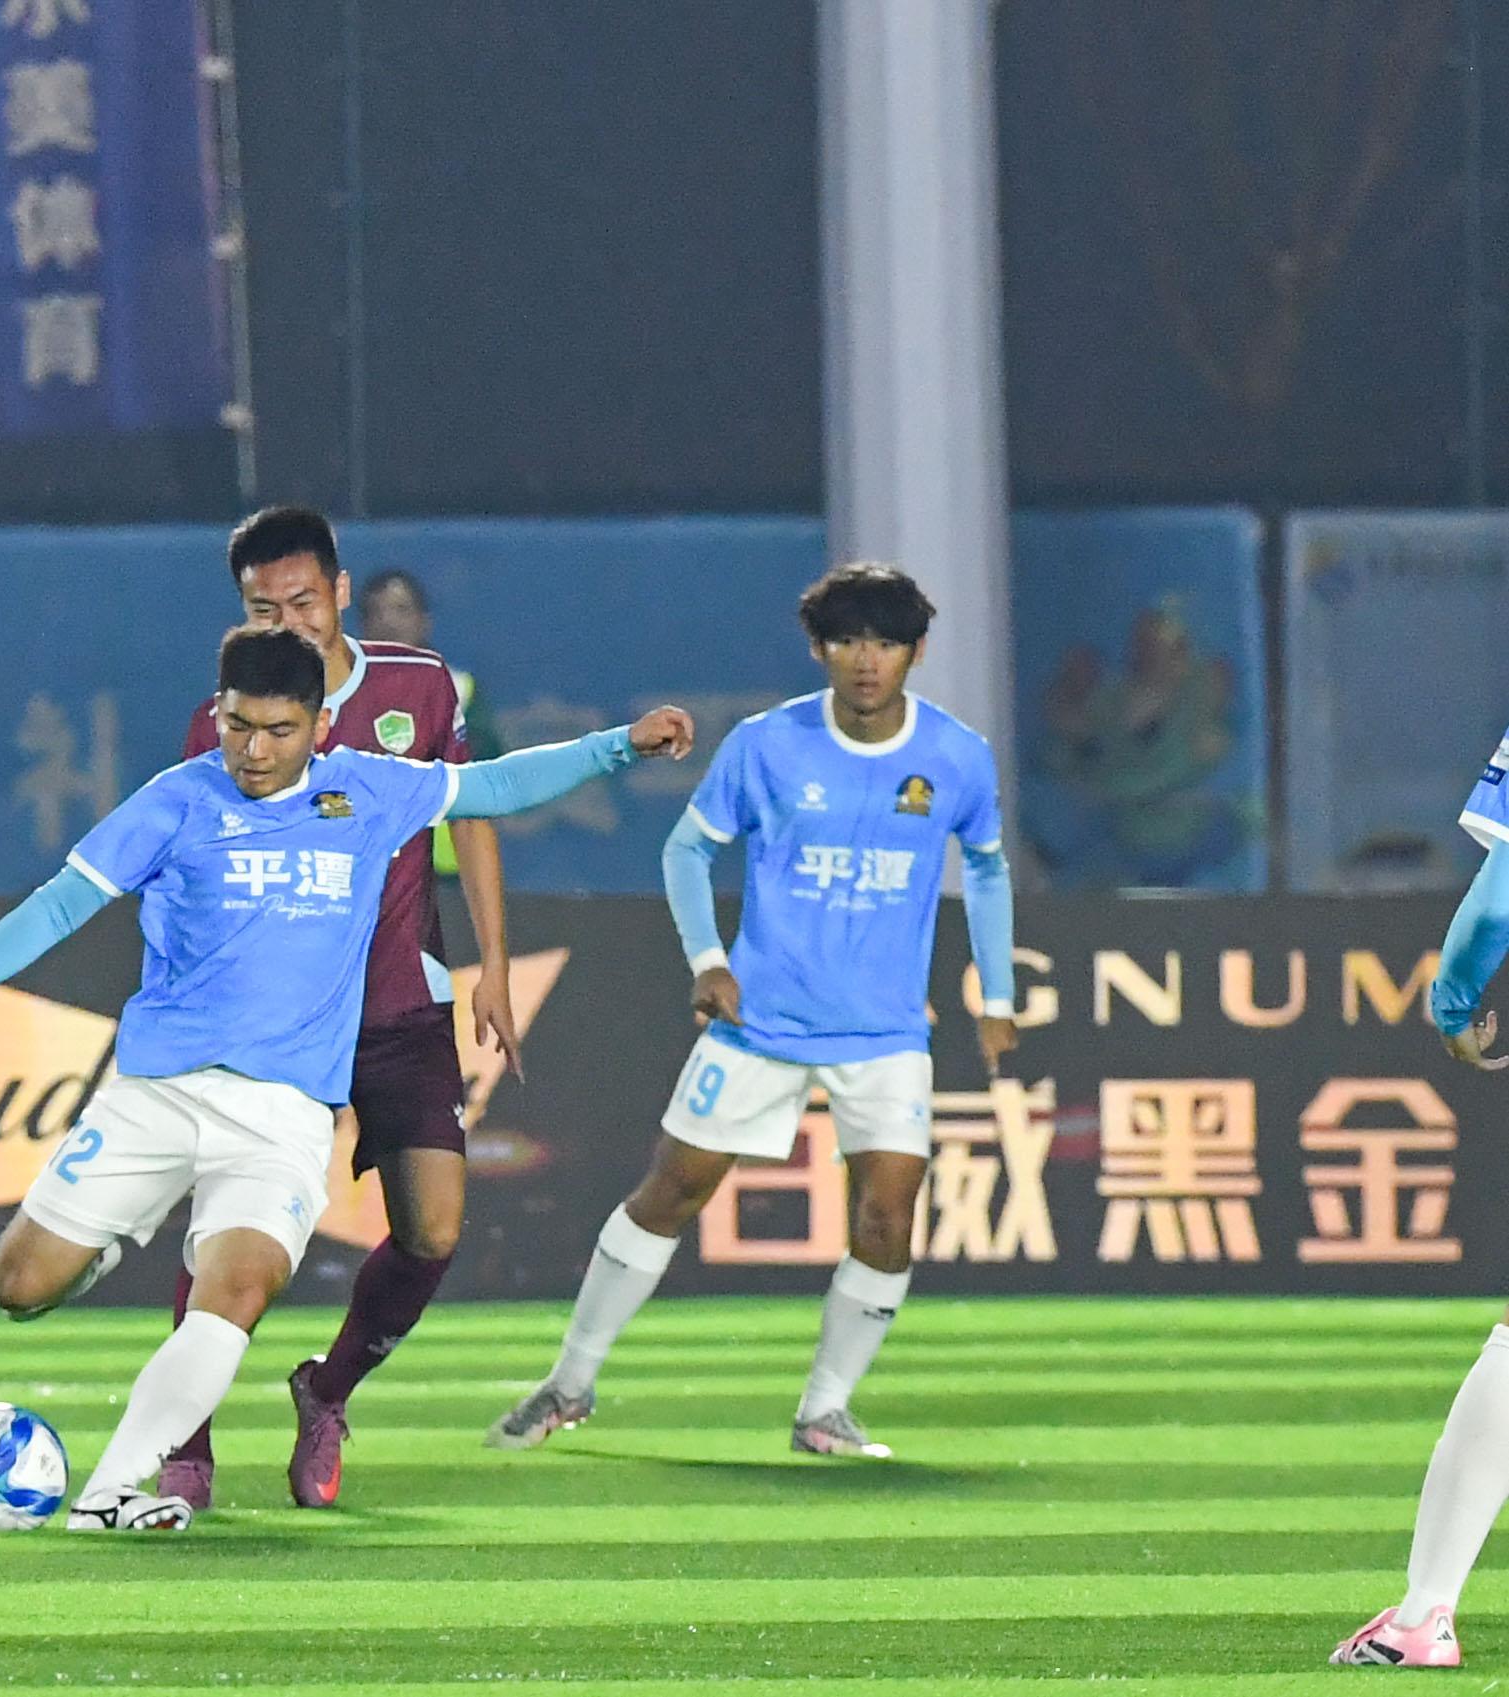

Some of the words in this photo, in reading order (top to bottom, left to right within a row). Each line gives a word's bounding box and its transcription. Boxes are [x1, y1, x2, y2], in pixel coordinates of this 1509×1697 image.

[223, 849, 355, 901] 平潭
[794, 845, 917, 892] 平潭
[926, 947, 1440, 1028] GNUM
[52, 1121, 104, 1185] 2
